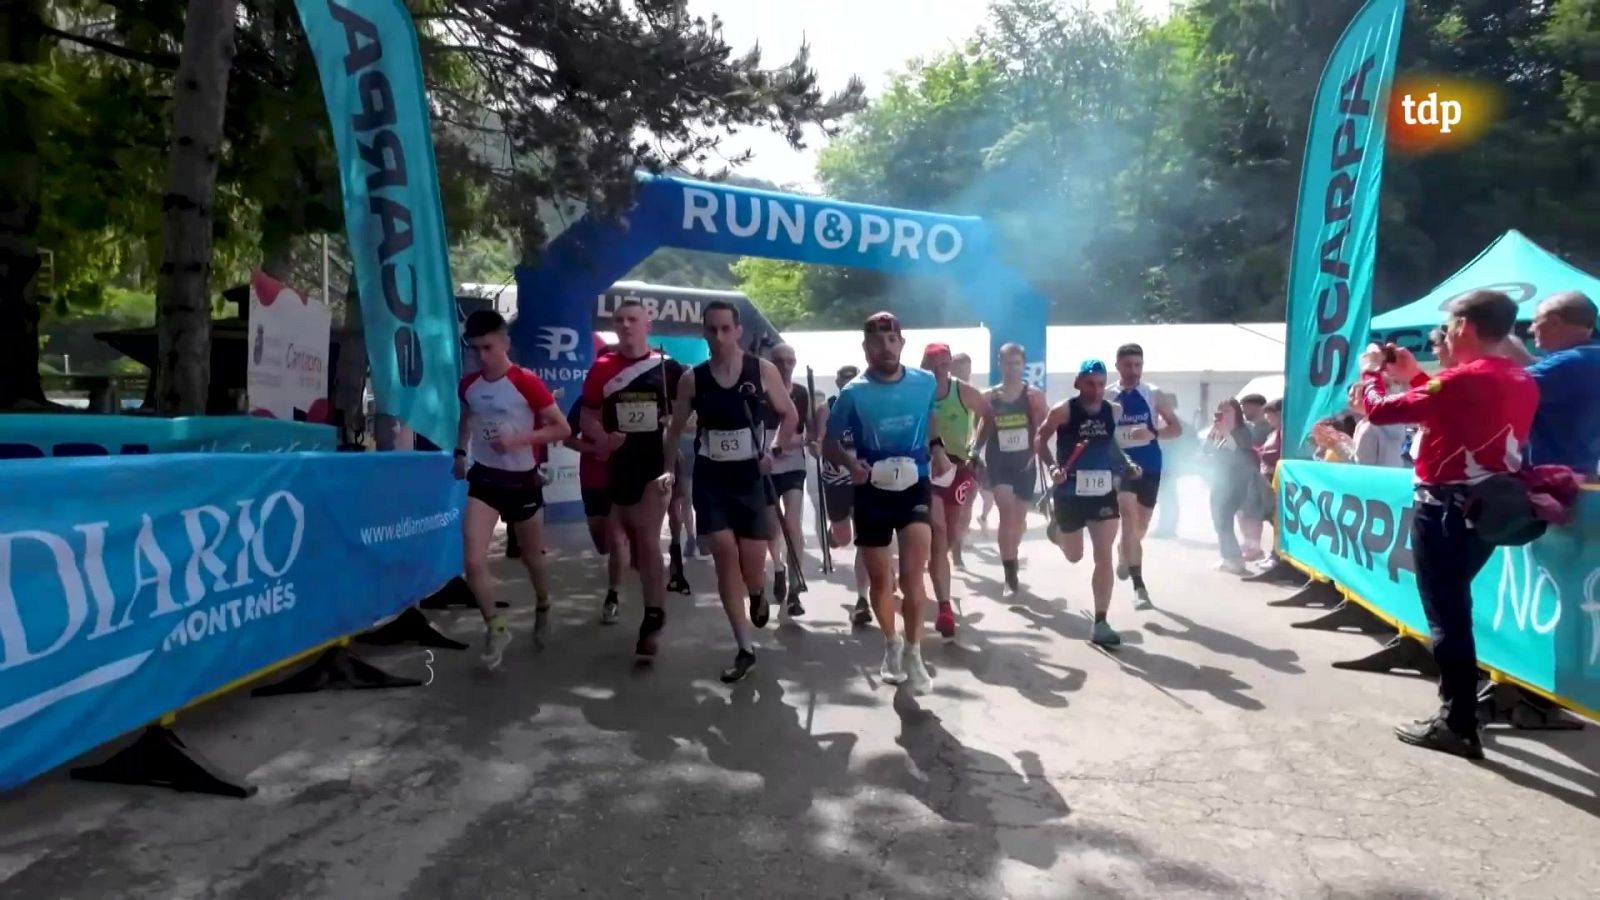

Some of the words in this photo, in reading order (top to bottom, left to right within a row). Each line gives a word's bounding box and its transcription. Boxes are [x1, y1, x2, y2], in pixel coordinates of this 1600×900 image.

[681, 186, 964, 265] RUN&PRO
[1309, 54, 1376, 389] SCARPA
[628, 411, 645, 424] 22
[720, 439, 740, 452] 63
[1084, 478, 1105, 489] 118
[0, 489, 305, 670] DIARIO
